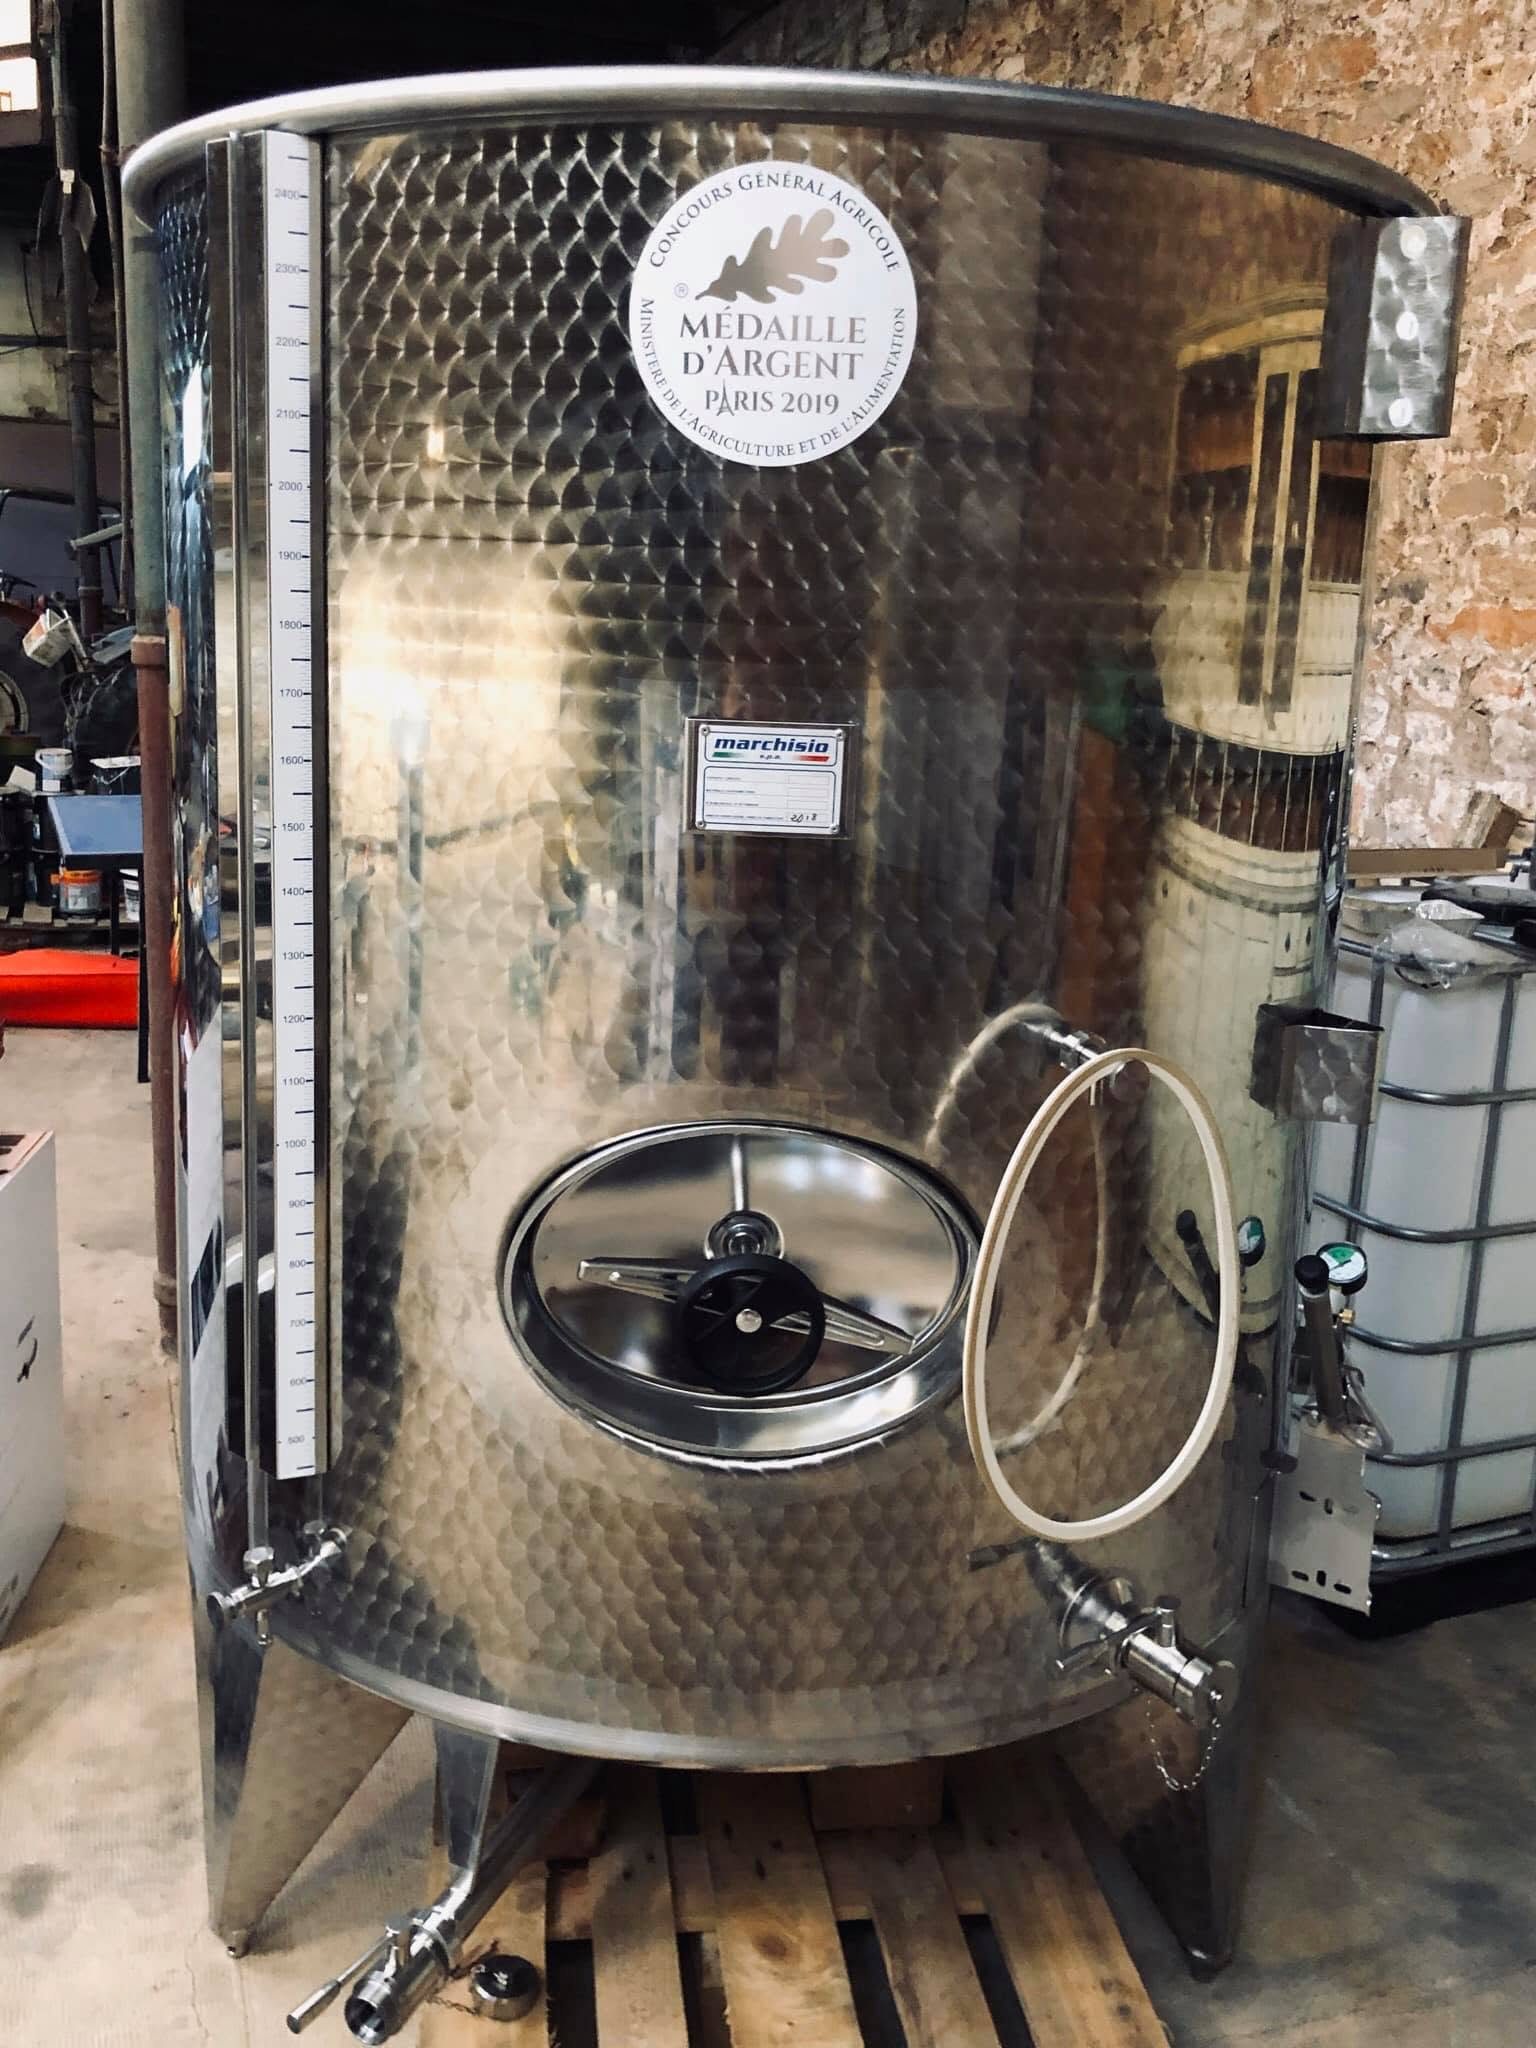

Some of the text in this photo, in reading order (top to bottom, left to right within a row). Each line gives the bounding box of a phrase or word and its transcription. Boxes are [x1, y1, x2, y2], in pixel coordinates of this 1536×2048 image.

[650, 170, 901, 272] CONCOURS GÉNÉRAL AGRICOLE
[275, 263, 300, 273] 2300
[680, 305, 867, 344] MÉDAILLE
[275, 336, 301, 348] 2200
[683, 344, 864, 380] D'ARGENT
[663, 388, 682, 411] DE
[678, 408, 793, 457] L'AGRICULTURE
[799, 438, 817, 454] ET
[820, 427, 841, 446] DE
[841, 307, 905, 432] L'ALIMENTATION
[705, 379, 840, 417] PARIS 2019
[276, 408, 301, 419] 2100
[278, 481, 303, 491] 2000
[279, 550, 302, 561] 1900
[279, 620, 303, 630] 1800
[280, 688, 303, 698] 1700
[714, 737, 829, 753] marchisio
[280, 756, 304, 765] 1600
[282, 822, 305, 832] 1500
[282, 887, 305, 896] 1400
[283, 951, 305, 961] 1300
[283, 1014, 305, 1024] 1200
[283, 1077, 305, 1086] 1100
[284, 1139, 307, 1148] 1000
[288, 1199, 306, 1208] 900
